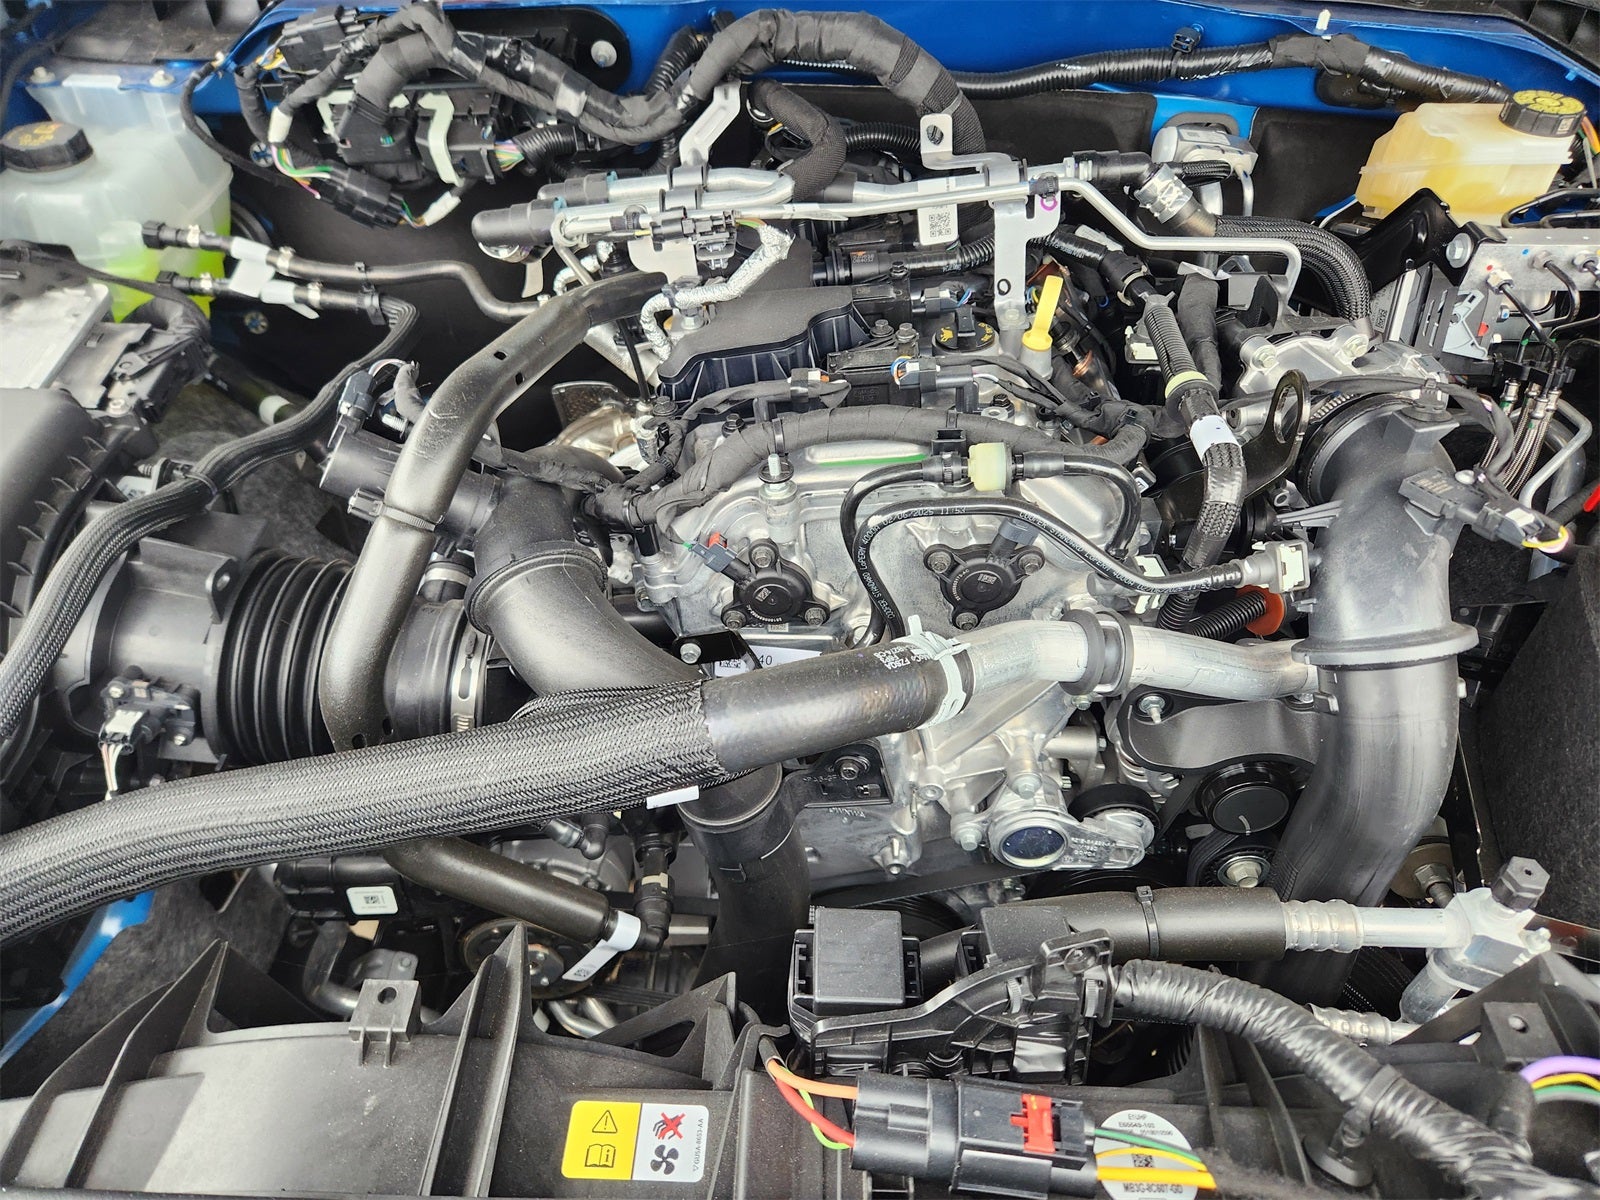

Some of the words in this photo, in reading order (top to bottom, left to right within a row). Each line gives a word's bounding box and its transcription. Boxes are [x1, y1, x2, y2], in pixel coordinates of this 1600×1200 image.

[882, 508, 934, 525] 02/06/2025
[862, 571, 882, 598] STANDARD
[878, 599, 895, 619] COOPER
